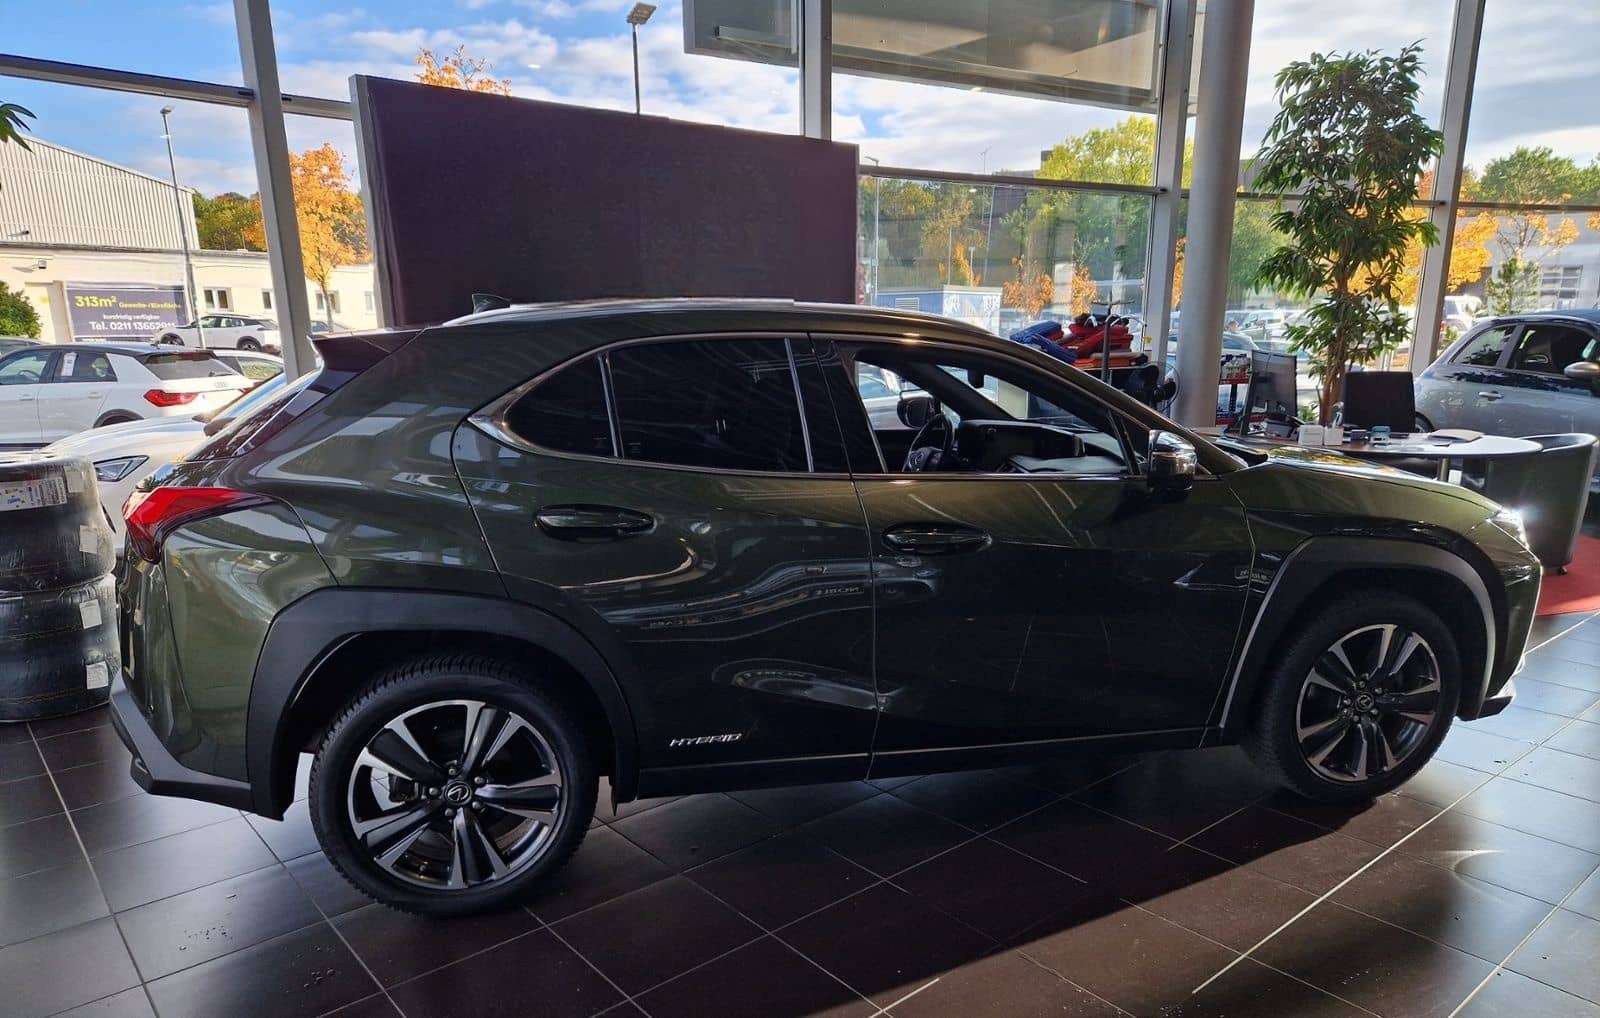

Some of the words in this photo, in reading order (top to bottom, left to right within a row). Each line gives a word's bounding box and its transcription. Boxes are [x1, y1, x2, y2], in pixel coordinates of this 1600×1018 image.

[89, 321, 108, 330] Tel.
[110, 321, 131, 330] 0211
[669, 733, 742, 747] HYBRID
